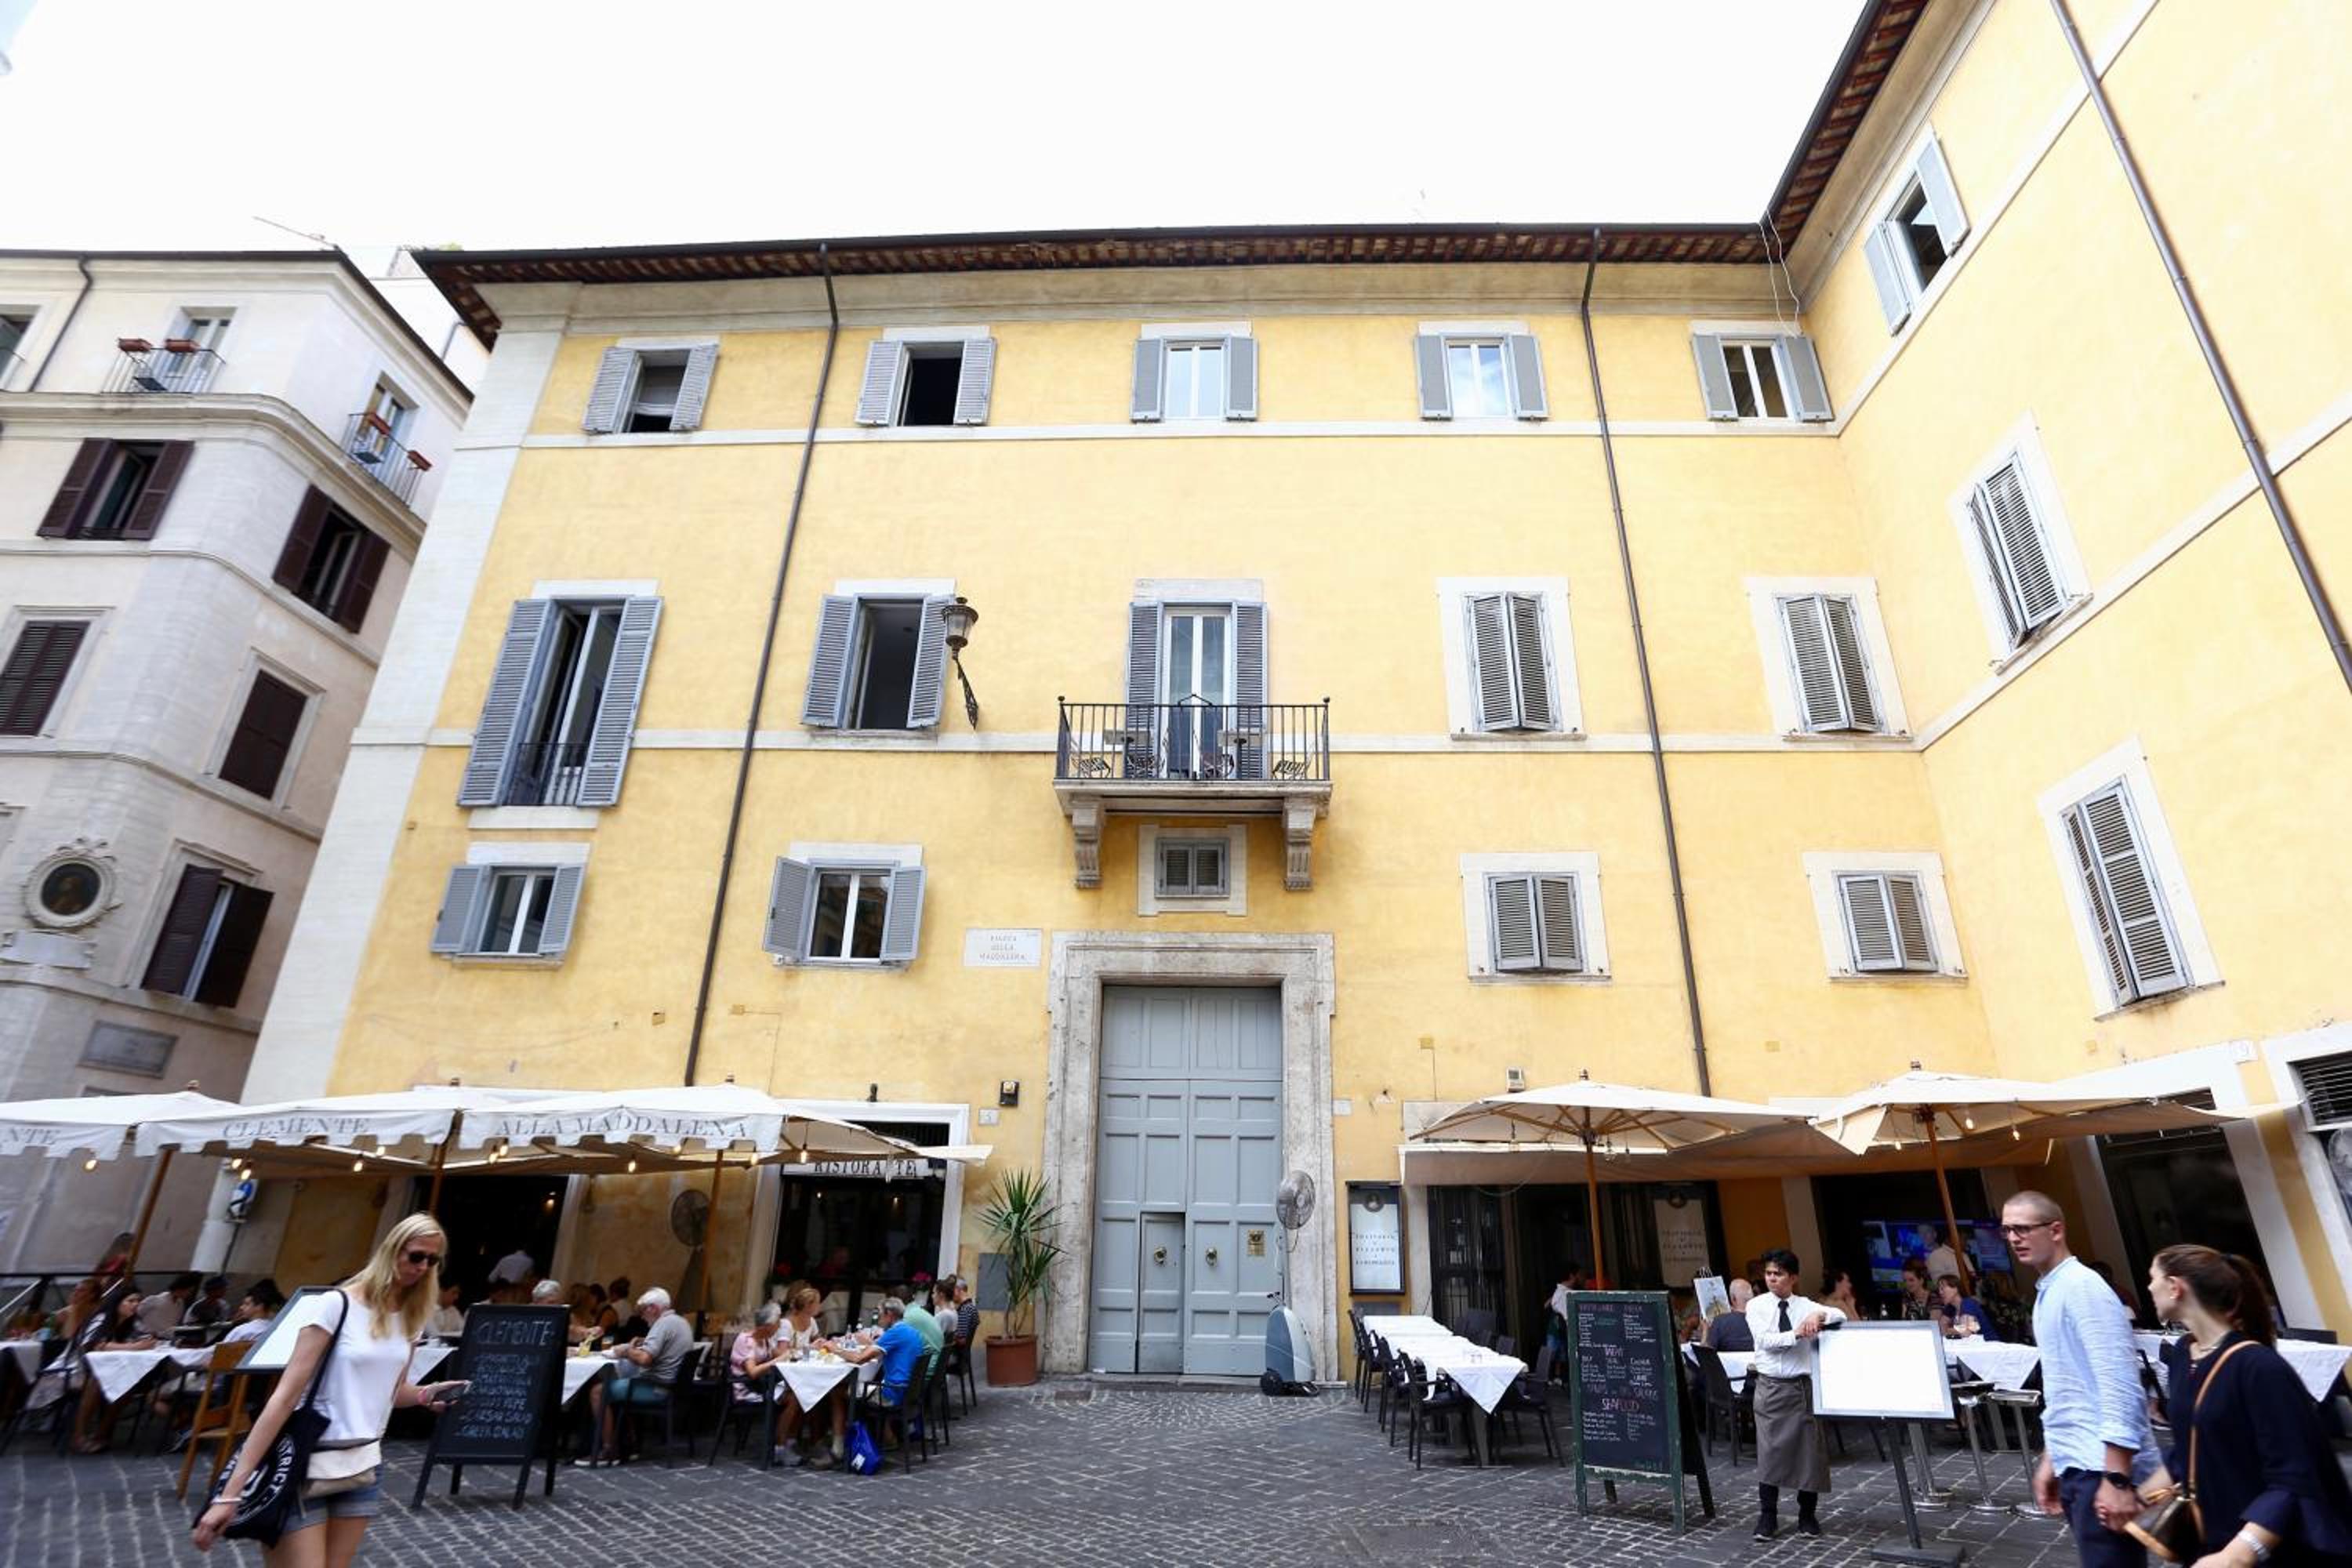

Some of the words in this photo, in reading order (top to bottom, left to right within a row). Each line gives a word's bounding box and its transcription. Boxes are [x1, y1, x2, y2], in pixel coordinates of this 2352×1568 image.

[223, 1117, 371, 1137] CLEMENTE
[495, 1120, 564, 1136] ALLA
[568, 1113, 747, 1137] MADDALENA
[814, 1160, 916, 1178] RISTORATE
[478, 1320, 552, 1346] CLEMENTE
